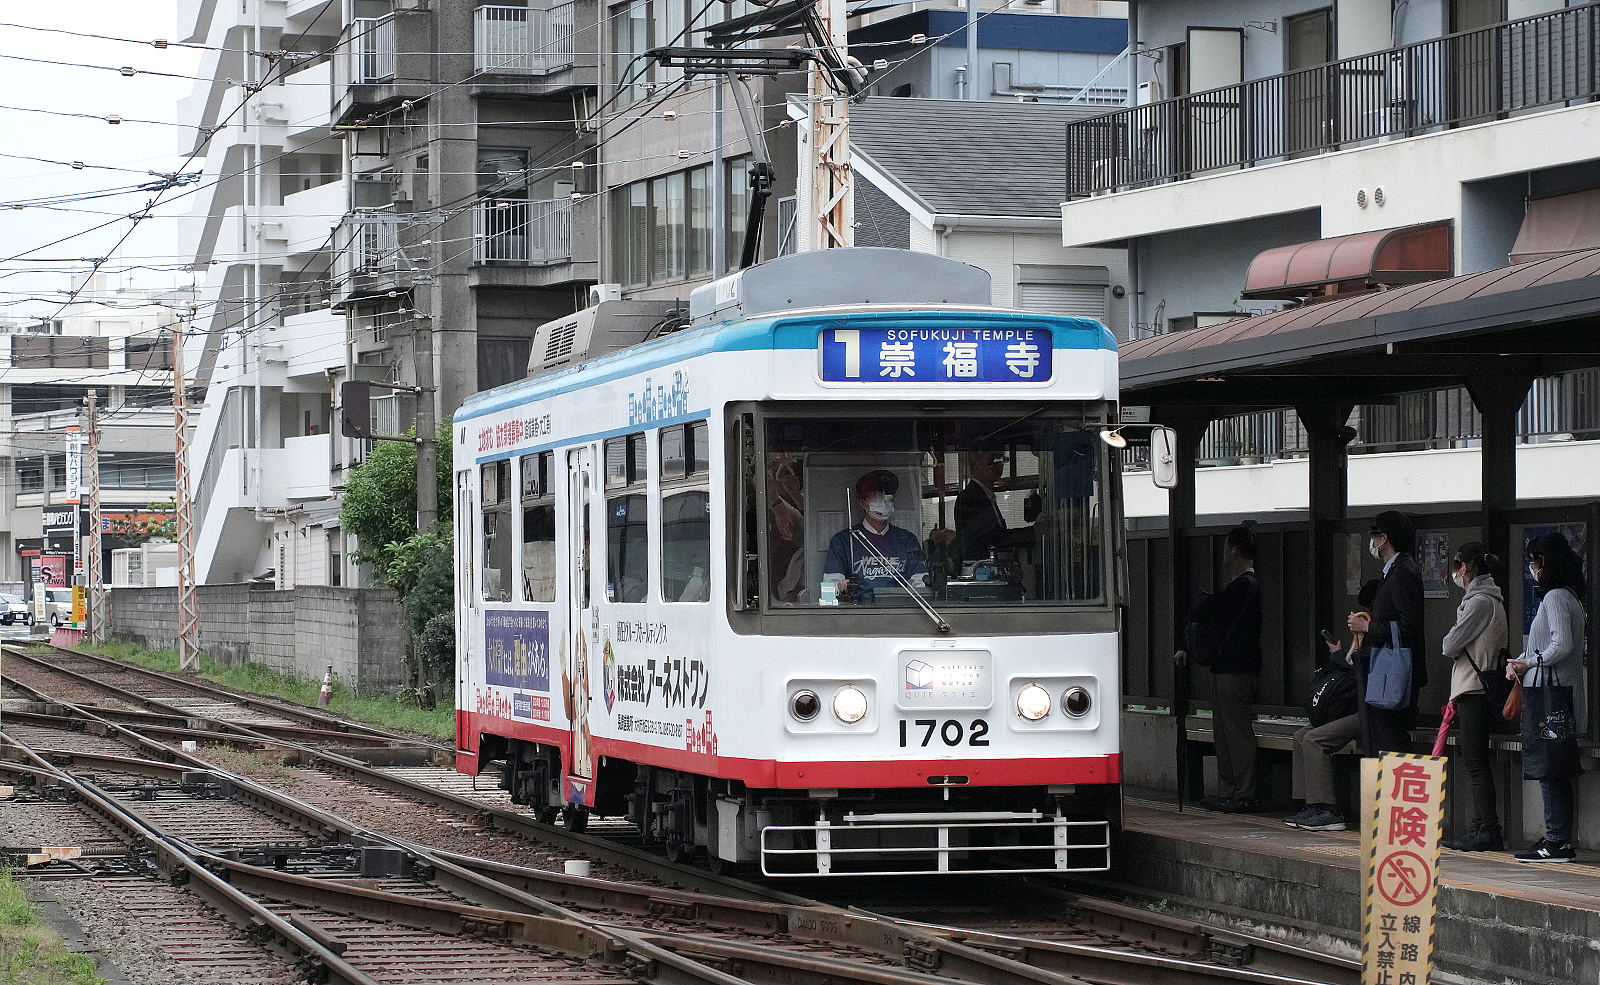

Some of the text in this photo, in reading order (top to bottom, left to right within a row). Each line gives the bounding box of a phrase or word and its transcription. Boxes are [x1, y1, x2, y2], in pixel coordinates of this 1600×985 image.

[887, 329, 1034, 341] SOFUKUJI TEMPLE
[835, 330, 860, 378] 1
[879, 342, 1040, 378] 崇福寺
[854, 558, 907, 579] Nagasaki
[77, 585, 85, 621] 電車に注意
[905, 691, 934, 700] QUIE
[899, 719, 990, 748] 1702
[1388, 762, 1432, 848] 危険
[1376, 912, 1398, 985] 立入禁止
[1399, 914, 1422, 985] 線路内
